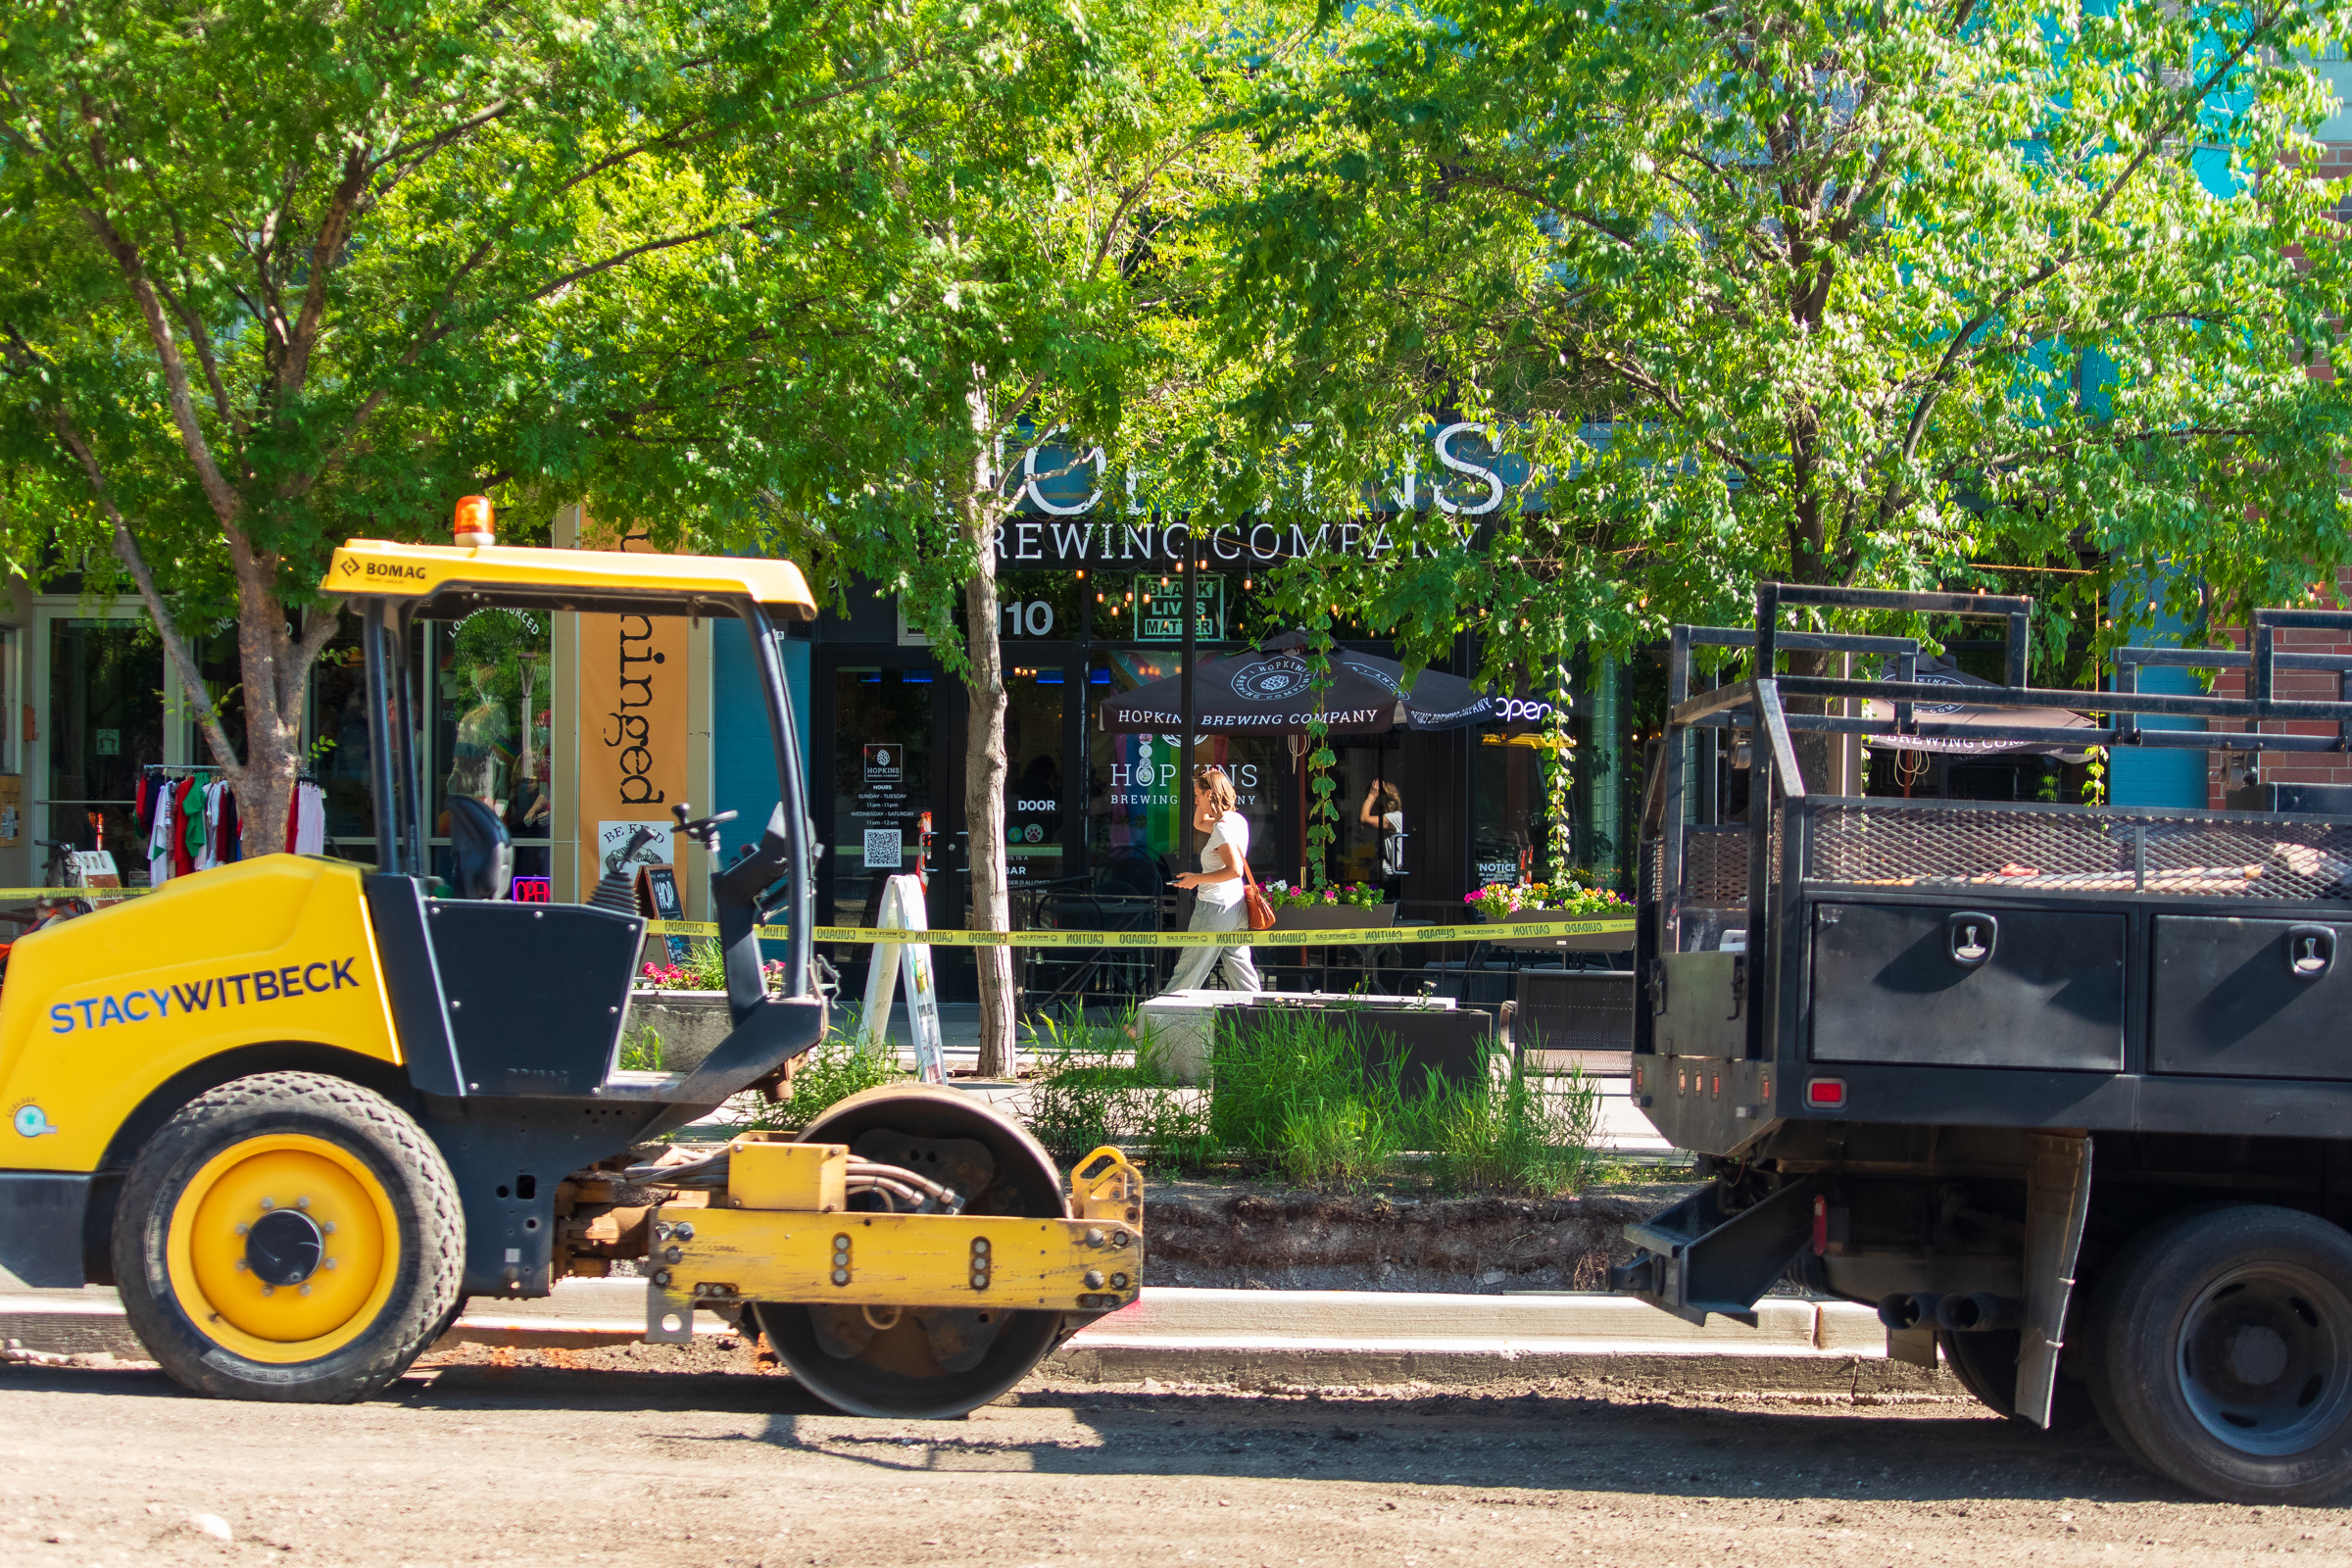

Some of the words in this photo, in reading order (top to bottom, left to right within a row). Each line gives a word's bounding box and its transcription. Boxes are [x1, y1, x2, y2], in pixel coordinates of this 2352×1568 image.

[367, 562, 426, 580] BOMAG
[1150, 582, 1211, 597] BLAK
[1152, 601, 1206, 615] LIVS
[1147, 620, 1211, 634] MATER
[604, 533, 665, 805] inged
[1118, 710, 1184, 724] HOPKIN
[1200, 713, 1283, 726] BREWING
[1290, 709, 1378, 725] COMPANY
[1110, 763, 1257, 788] HOPNS
[1018, 800, 1055, 811] DOOR
[1111, 794, 1178, 805] BREWING
[604, 826, 624, 844] BE
[628, 824, 665, 844] KD
[1479, 863, 1517, 872] NOTICE
[515, 881, 551, 902] OPEN
[50, 956, 360, 1034] STACYWITBECK
